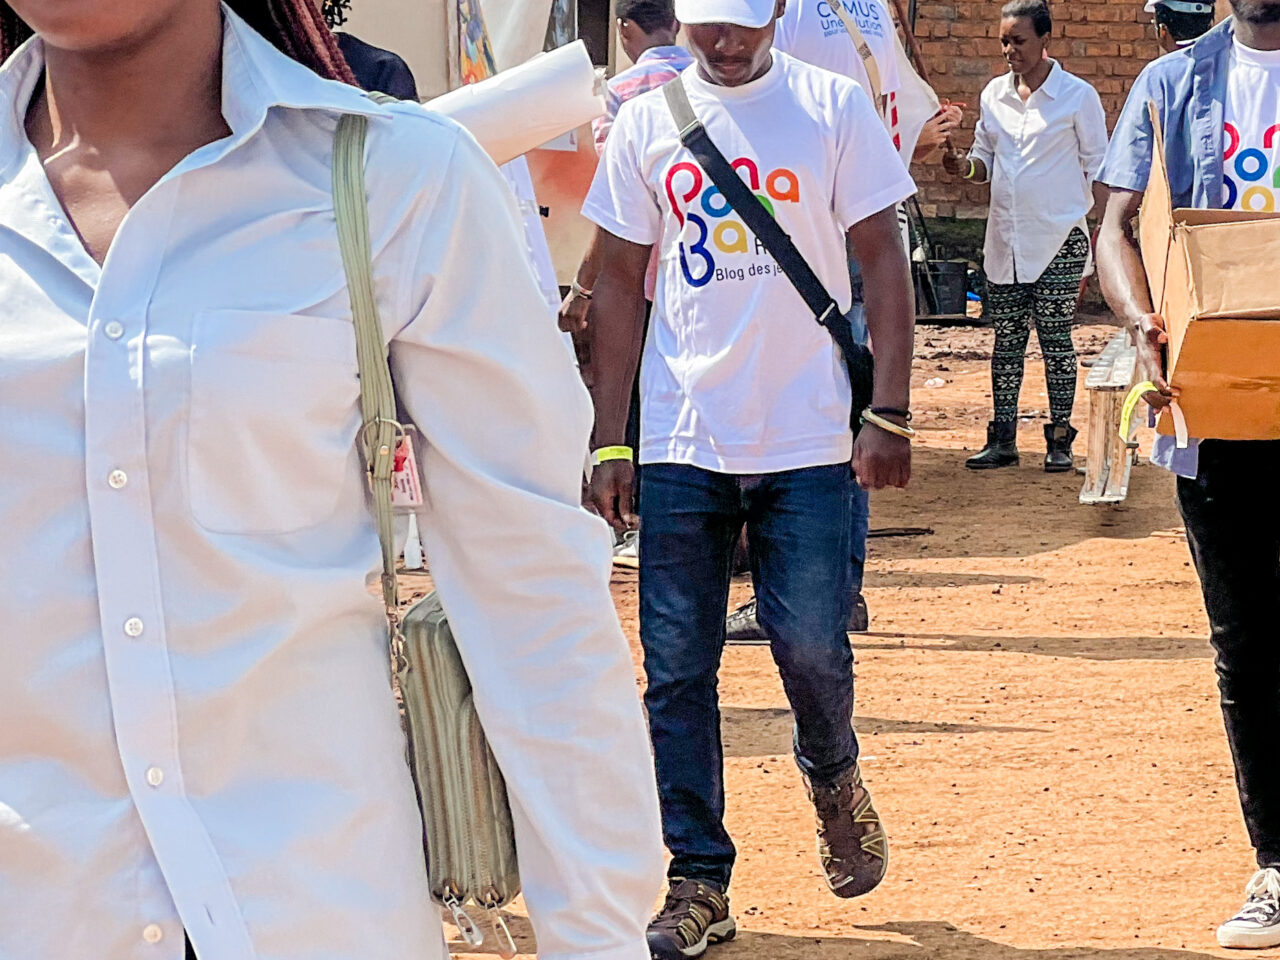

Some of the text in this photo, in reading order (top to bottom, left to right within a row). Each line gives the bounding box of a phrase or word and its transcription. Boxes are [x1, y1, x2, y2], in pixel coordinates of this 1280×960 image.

[816, 0, 879, 20] CMUS
[716, 268, 745, 282] Blog
[749, 263, 771, 277] des
